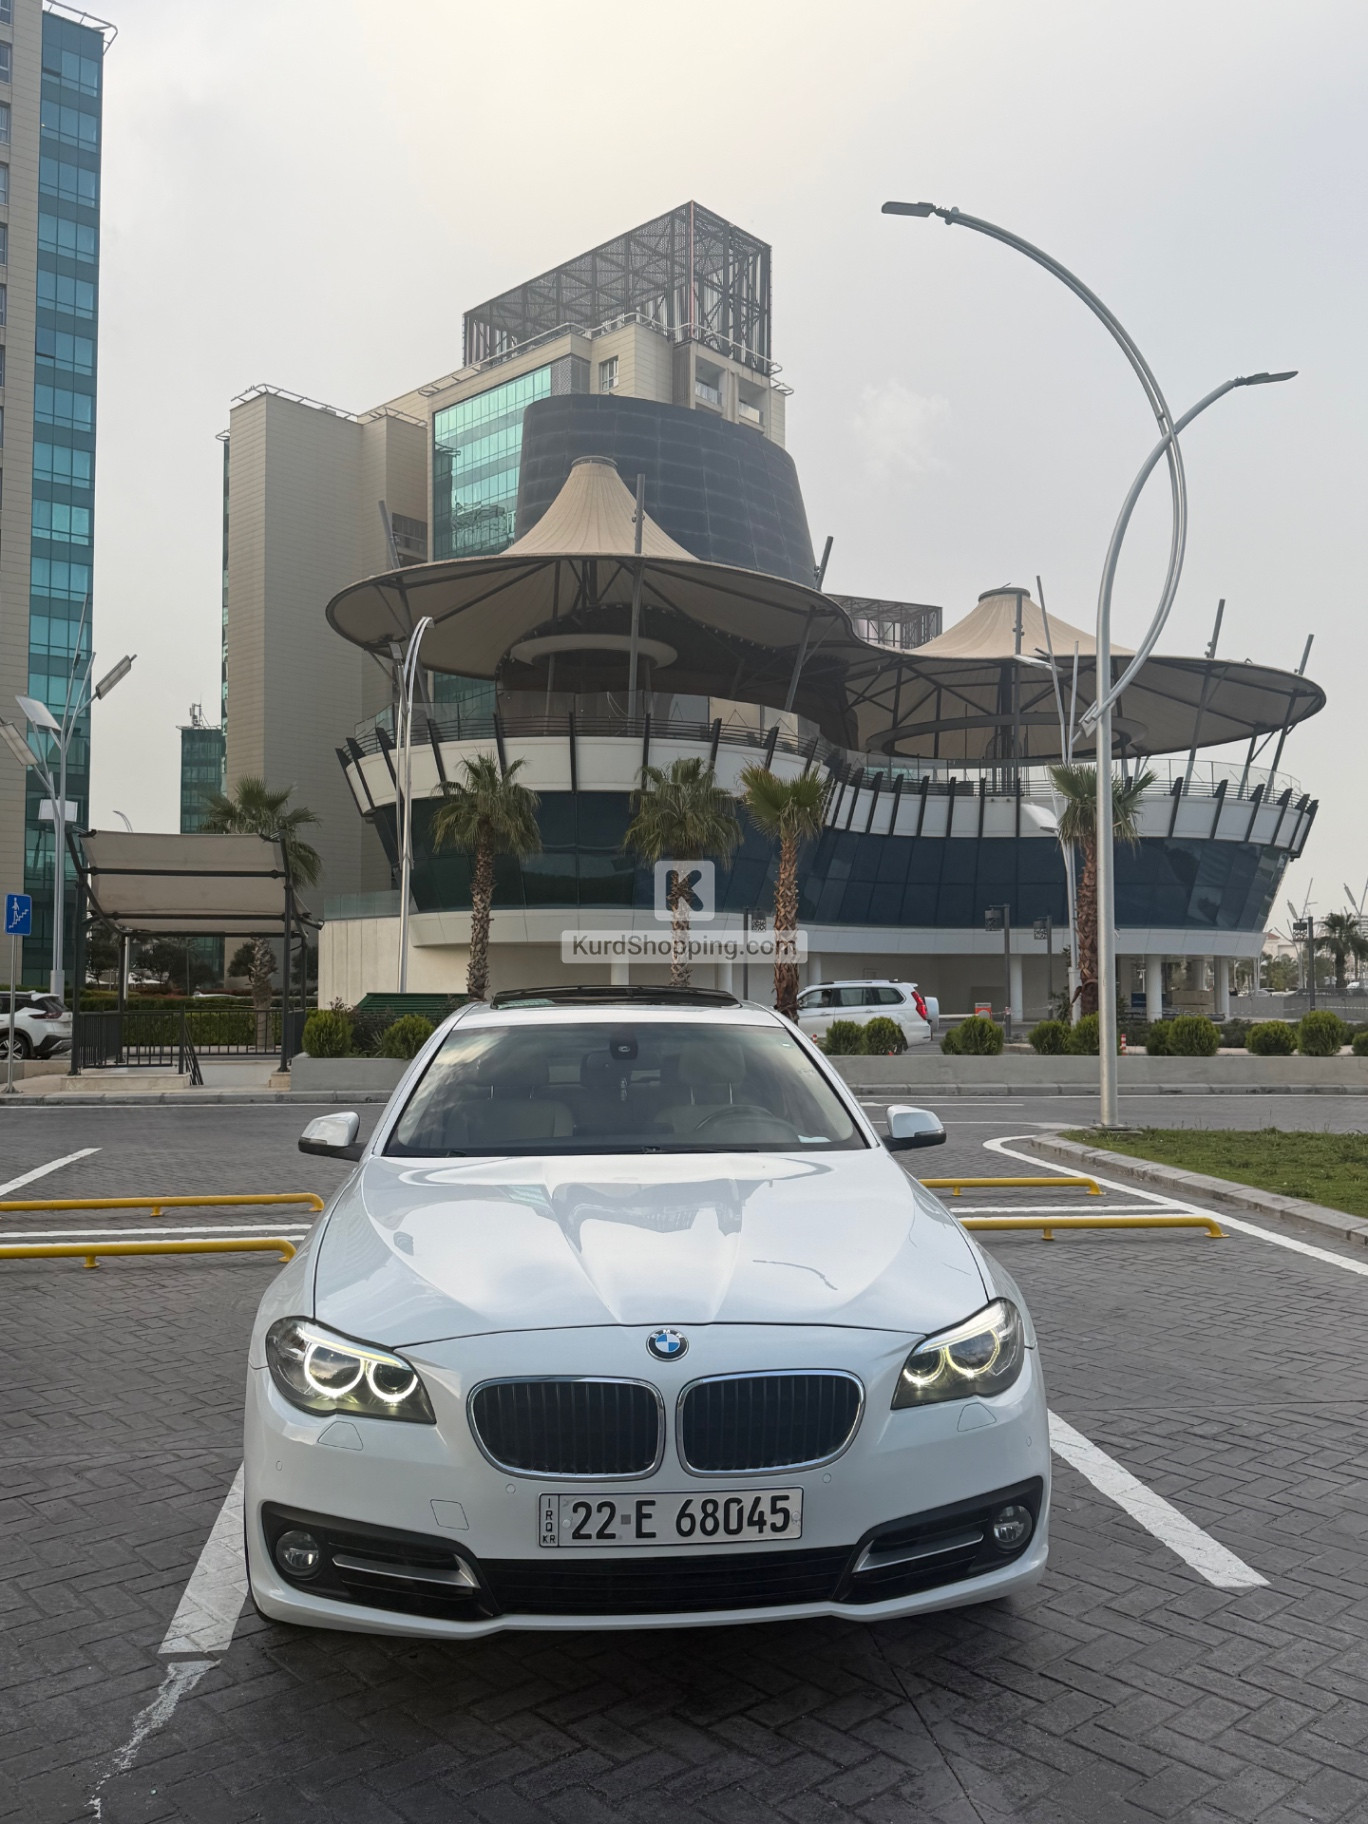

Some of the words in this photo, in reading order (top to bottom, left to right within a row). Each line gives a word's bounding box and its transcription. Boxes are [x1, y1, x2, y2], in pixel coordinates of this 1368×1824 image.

[571, 1500, 617, 1540] 22
[635, 1500, 657, 1539] E
[675, 1495, 790, 1537] 68045
[542, 1535, 556, 1544] KR
